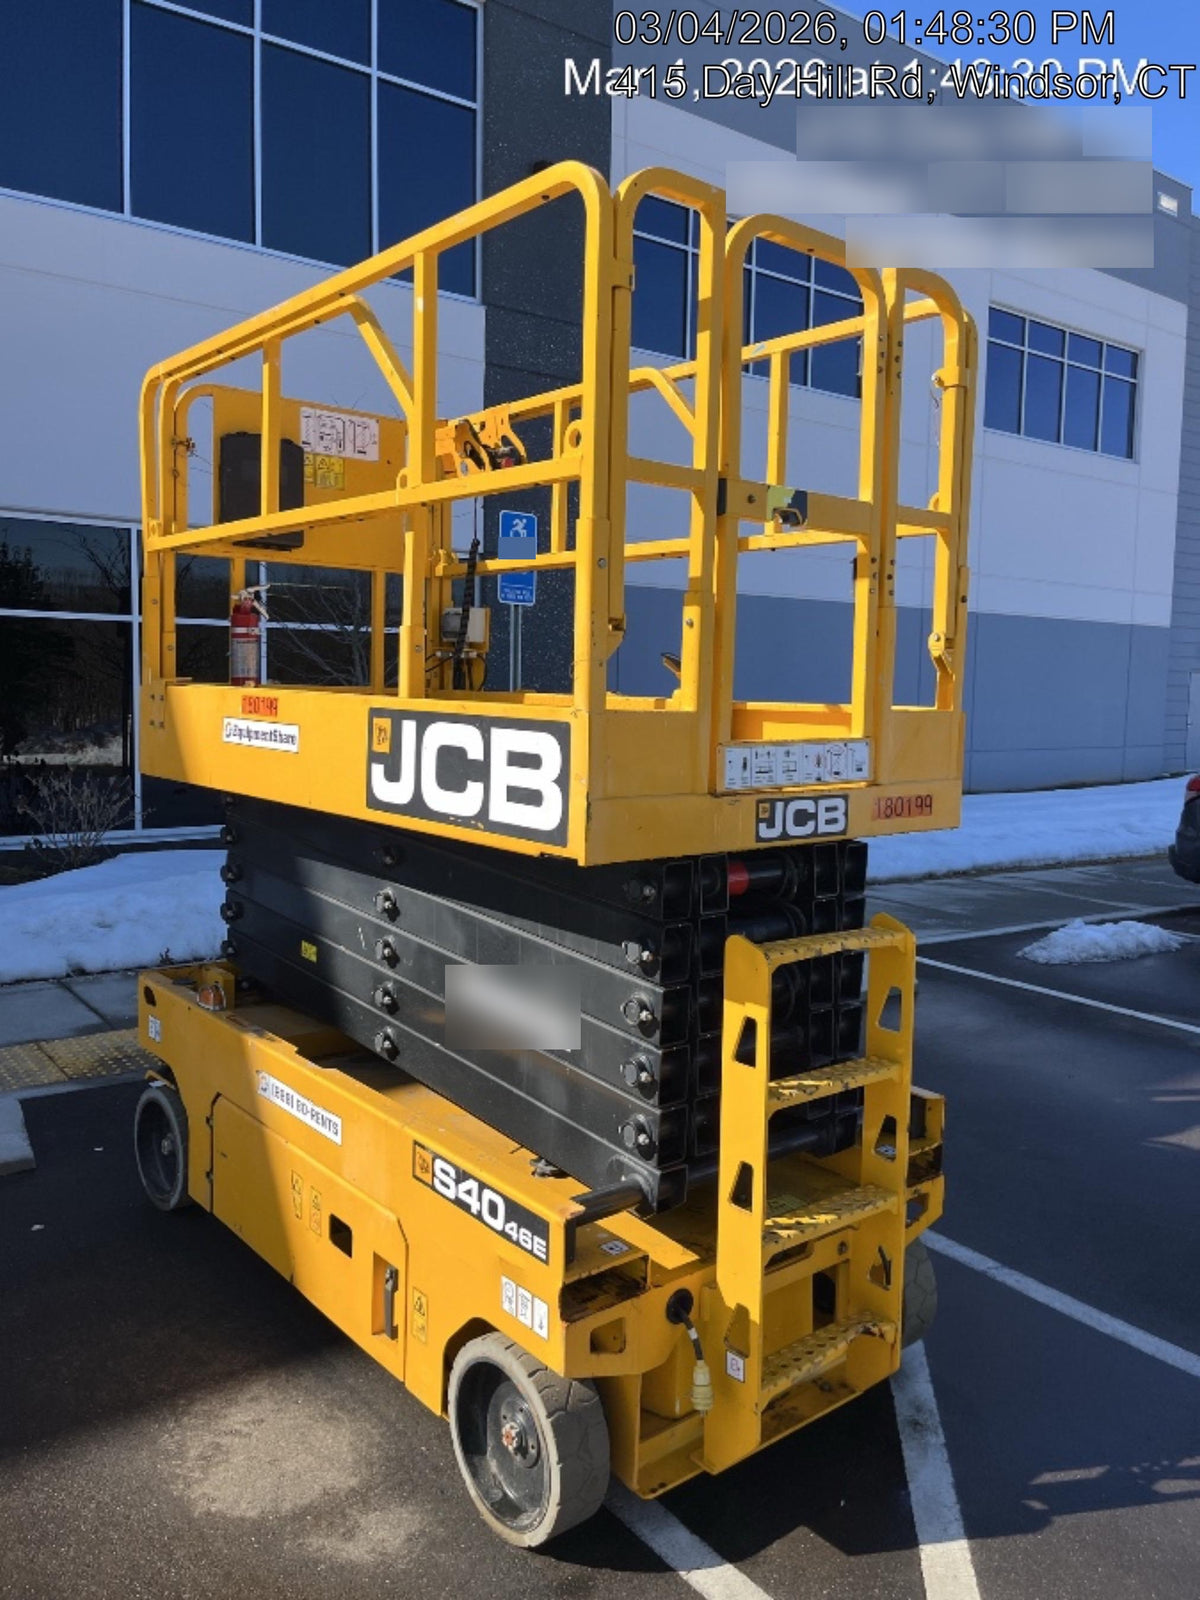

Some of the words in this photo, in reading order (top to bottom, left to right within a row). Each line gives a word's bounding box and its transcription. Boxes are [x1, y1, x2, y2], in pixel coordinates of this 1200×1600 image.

[371, 719, 562, 831] JCB
[758, 797, 846, 838] JCB
[874, 794, 933, 818] 180199
